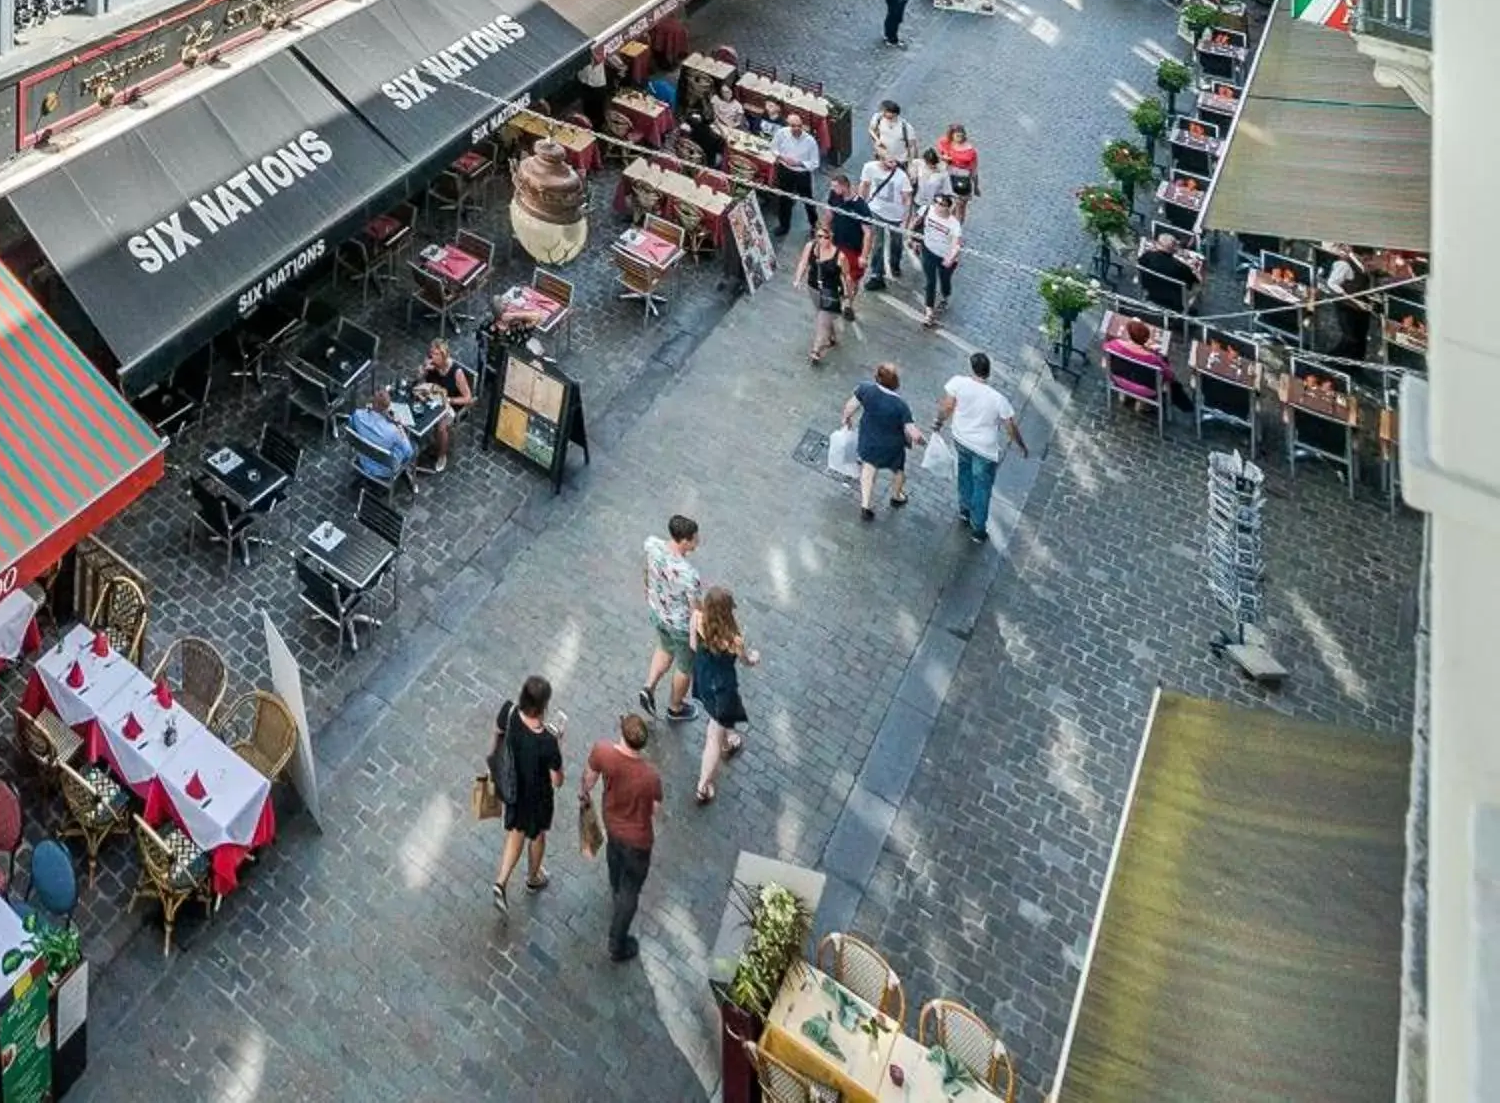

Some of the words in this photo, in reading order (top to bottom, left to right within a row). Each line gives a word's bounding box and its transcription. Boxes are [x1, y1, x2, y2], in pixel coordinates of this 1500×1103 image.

[380, 67, 438, 111] SIX
[419, 13, 526, 84] NATIONS
[471, 122, 491, 145] SIX
[127, 212, 202, 274] SIX
[189, 130, 333, 234] NATIONS
[237, 283, 265, 314] SIX
[265, 238, 326, 295] NATIONS
